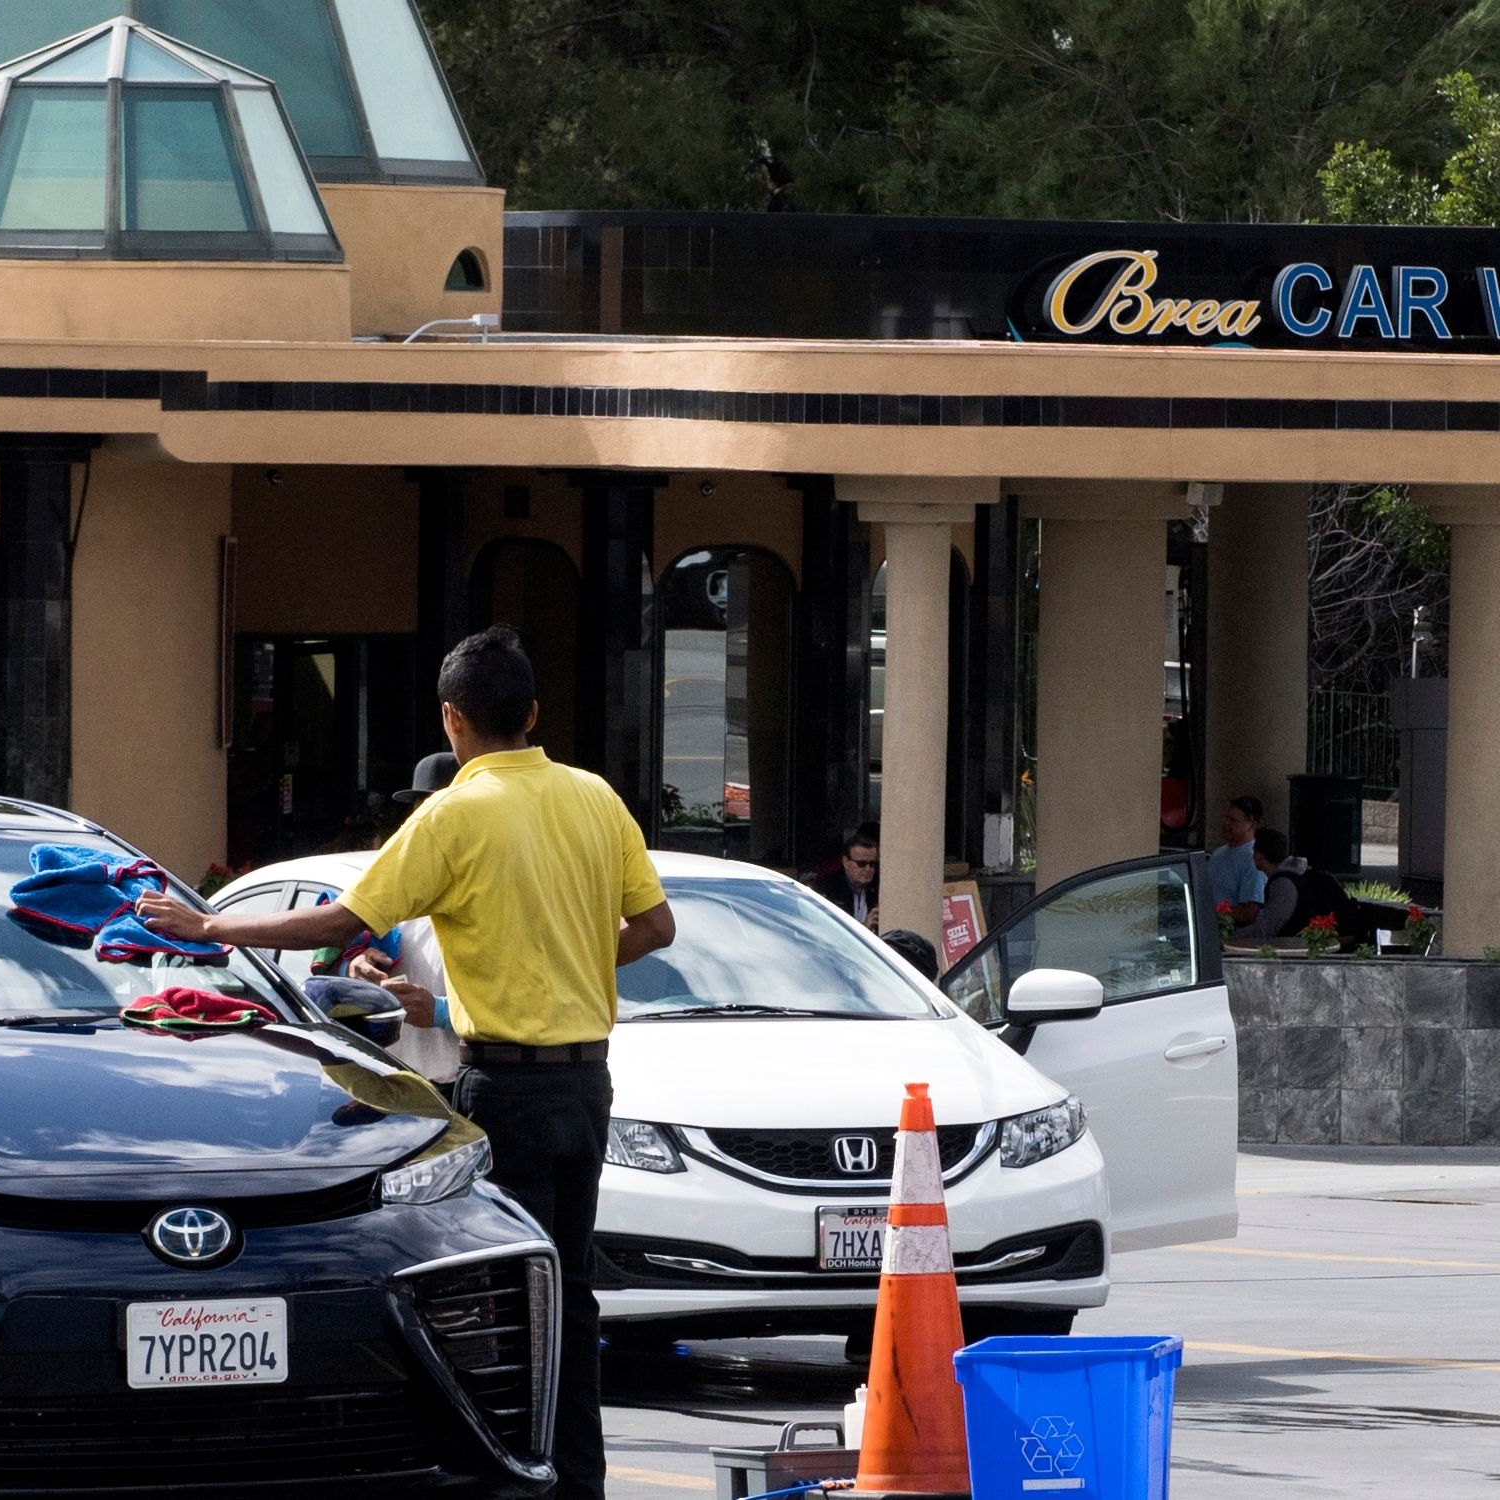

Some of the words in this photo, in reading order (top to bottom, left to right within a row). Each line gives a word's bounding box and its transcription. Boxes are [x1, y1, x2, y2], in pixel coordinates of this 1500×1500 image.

[1044, 249, 1261, 337] Brea
[1274, 262, 1453, 339] CAR
[828, 1230, 885, 1258] 7HXA
[827, 1259, 846, 1268] DCH
[848, 1259, 876, 1268] Honda
[161, 1306, 258, 1331] California
[139, 1331, 277, 1374] 7YPR204
[168, 1372, 249, 1383] dmv.ca.gov
